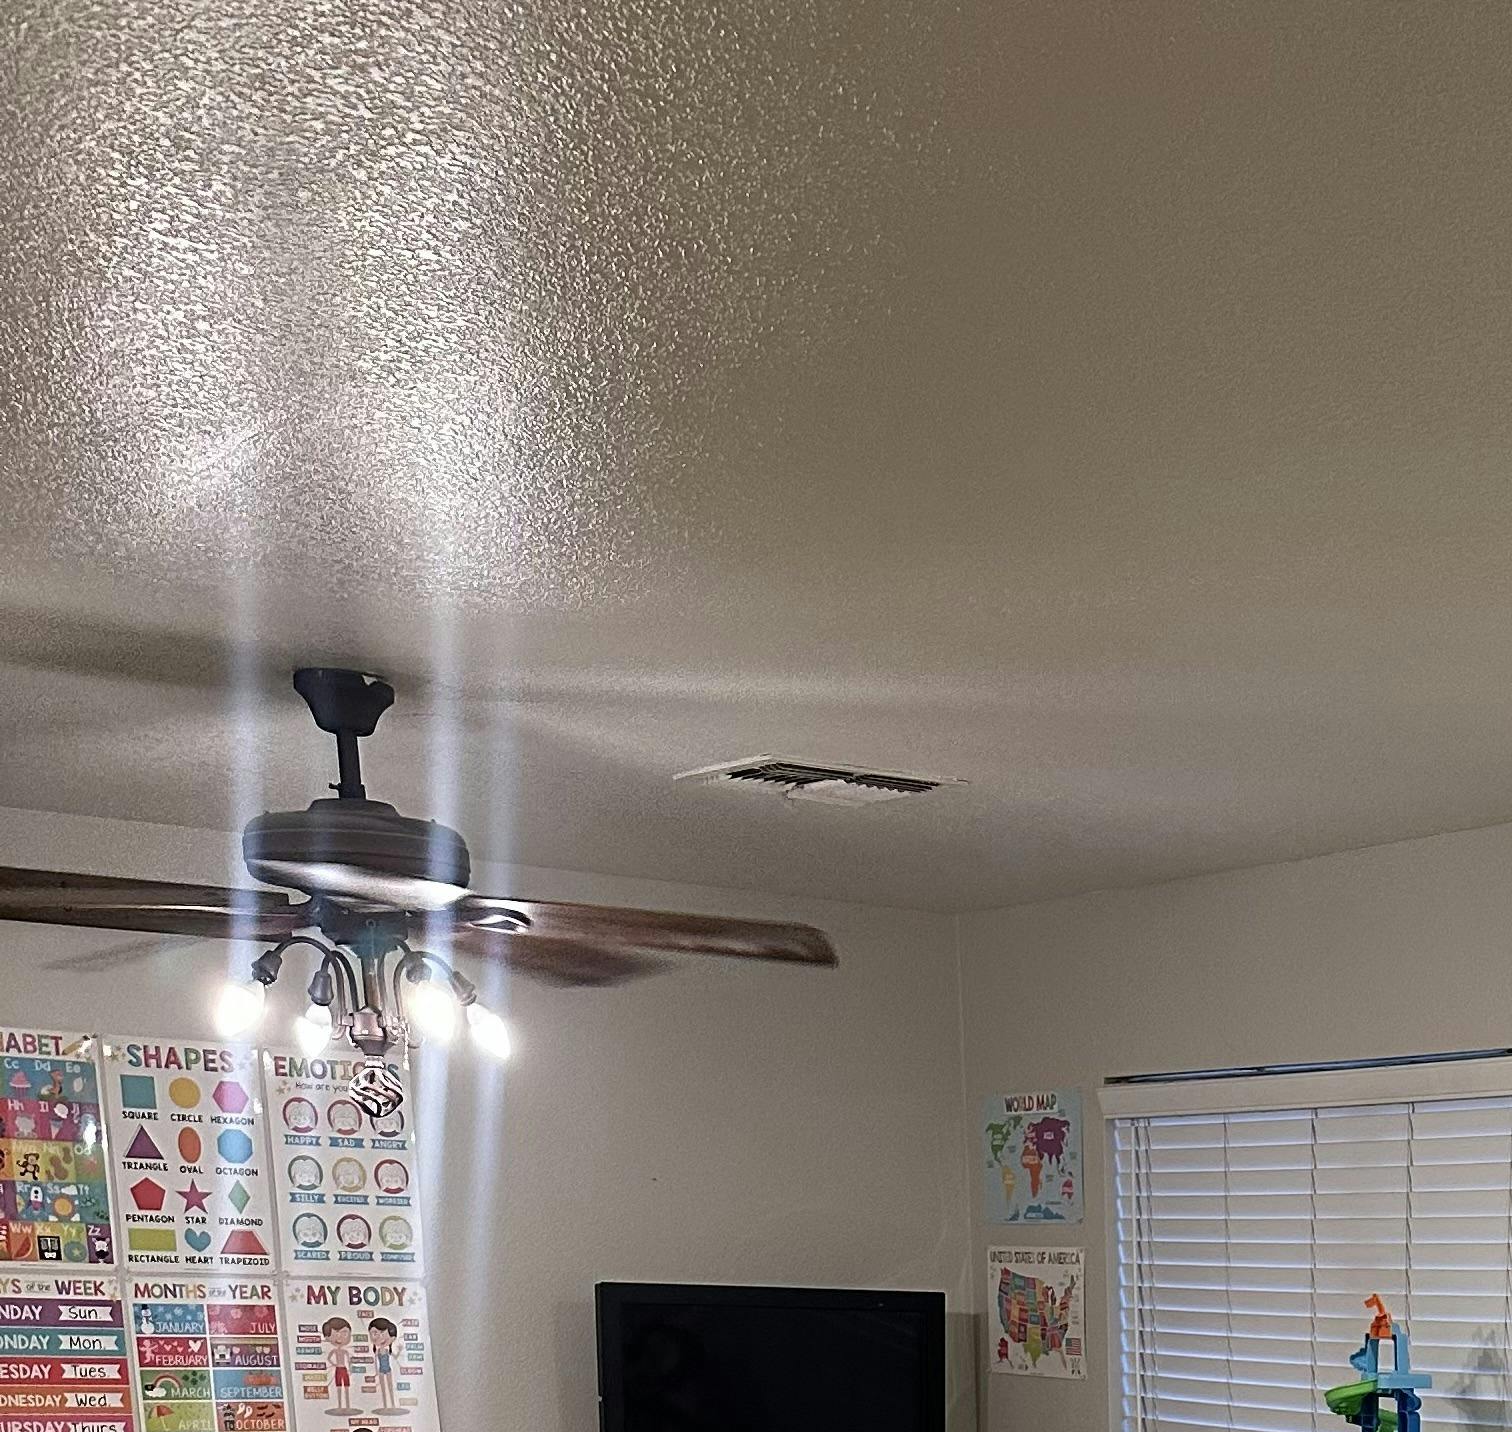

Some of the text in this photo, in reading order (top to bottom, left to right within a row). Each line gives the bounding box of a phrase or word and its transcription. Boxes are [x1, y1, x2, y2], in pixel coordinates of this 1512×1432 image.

[0, 1032, 63, 1056] ABET
[126, 1044, 236, 1073] SHAPES
[34, 1060, 51, 1071] Dd
[315, 1084, 330, 1092] are
[1004, 1094, 1057, 1112] WORLD MAP
[122, 1111, 159, 1121] SQUARE
[170, 1113, 204, 1123] CIRCLE
[210, 1115, 255, 1126] HEXAGON
[287, 1135, 318, 1146] HAPPY
[337, 1138, 356, 1148] SAD
[374, 1140, 404, 1150] ANGRY
[122, 1161, 169, 1172] TRIANGLE
[179, 1165, 204, 1174] OVAL
[215, 1166, 259, 1177] OCTAGON
[16, 1182, 30, 1192] Rr
[295, 1193, 320, 1203] SILLY
[125, 1213, 175, 1223] PENTAGON
[185, 1216, 207, 1225] STAR
[218, 1217, 264, 1227] DIAMOND
[9, 1223, 33, 1233] Ww
[88, 1225, 101, 1236] Zz
[128, 1254, 180, 1265] RECTANGLE
[185, 1256, 214, 1265] HEART
[219, 1256, 270, 1267] TRAPEZOID
[341, 1252, 371, 1261] PROUD
[1014, 1251, 1036, 1264] STATES
[1037, 1252, 1047, 1264] OF
[1048, 1252, 1080, 1265] AMERICA
[54, 1279, 106, 1296] WEEK
[134, 1283, 207, 1299] MONTHS
[228, 1284, 273, 1300] YEAR
[306, 1285, 407, 1307] MY BODY
[155, 1321, 205, 1334] JANUARY
[250, 1322, 276, 1334] JULY
[155, 1354, 209, 1366] FEBRUARY
[235, 1355, 278, 1366] AUGUST
[170, 1387, 211, 1399] MARCH
[220, 1386, 283, 1398] SEPTEMBER
[178, 1420, 213, 1431] APRIL
[235, 1419, 285, 1431] OCTOBER
